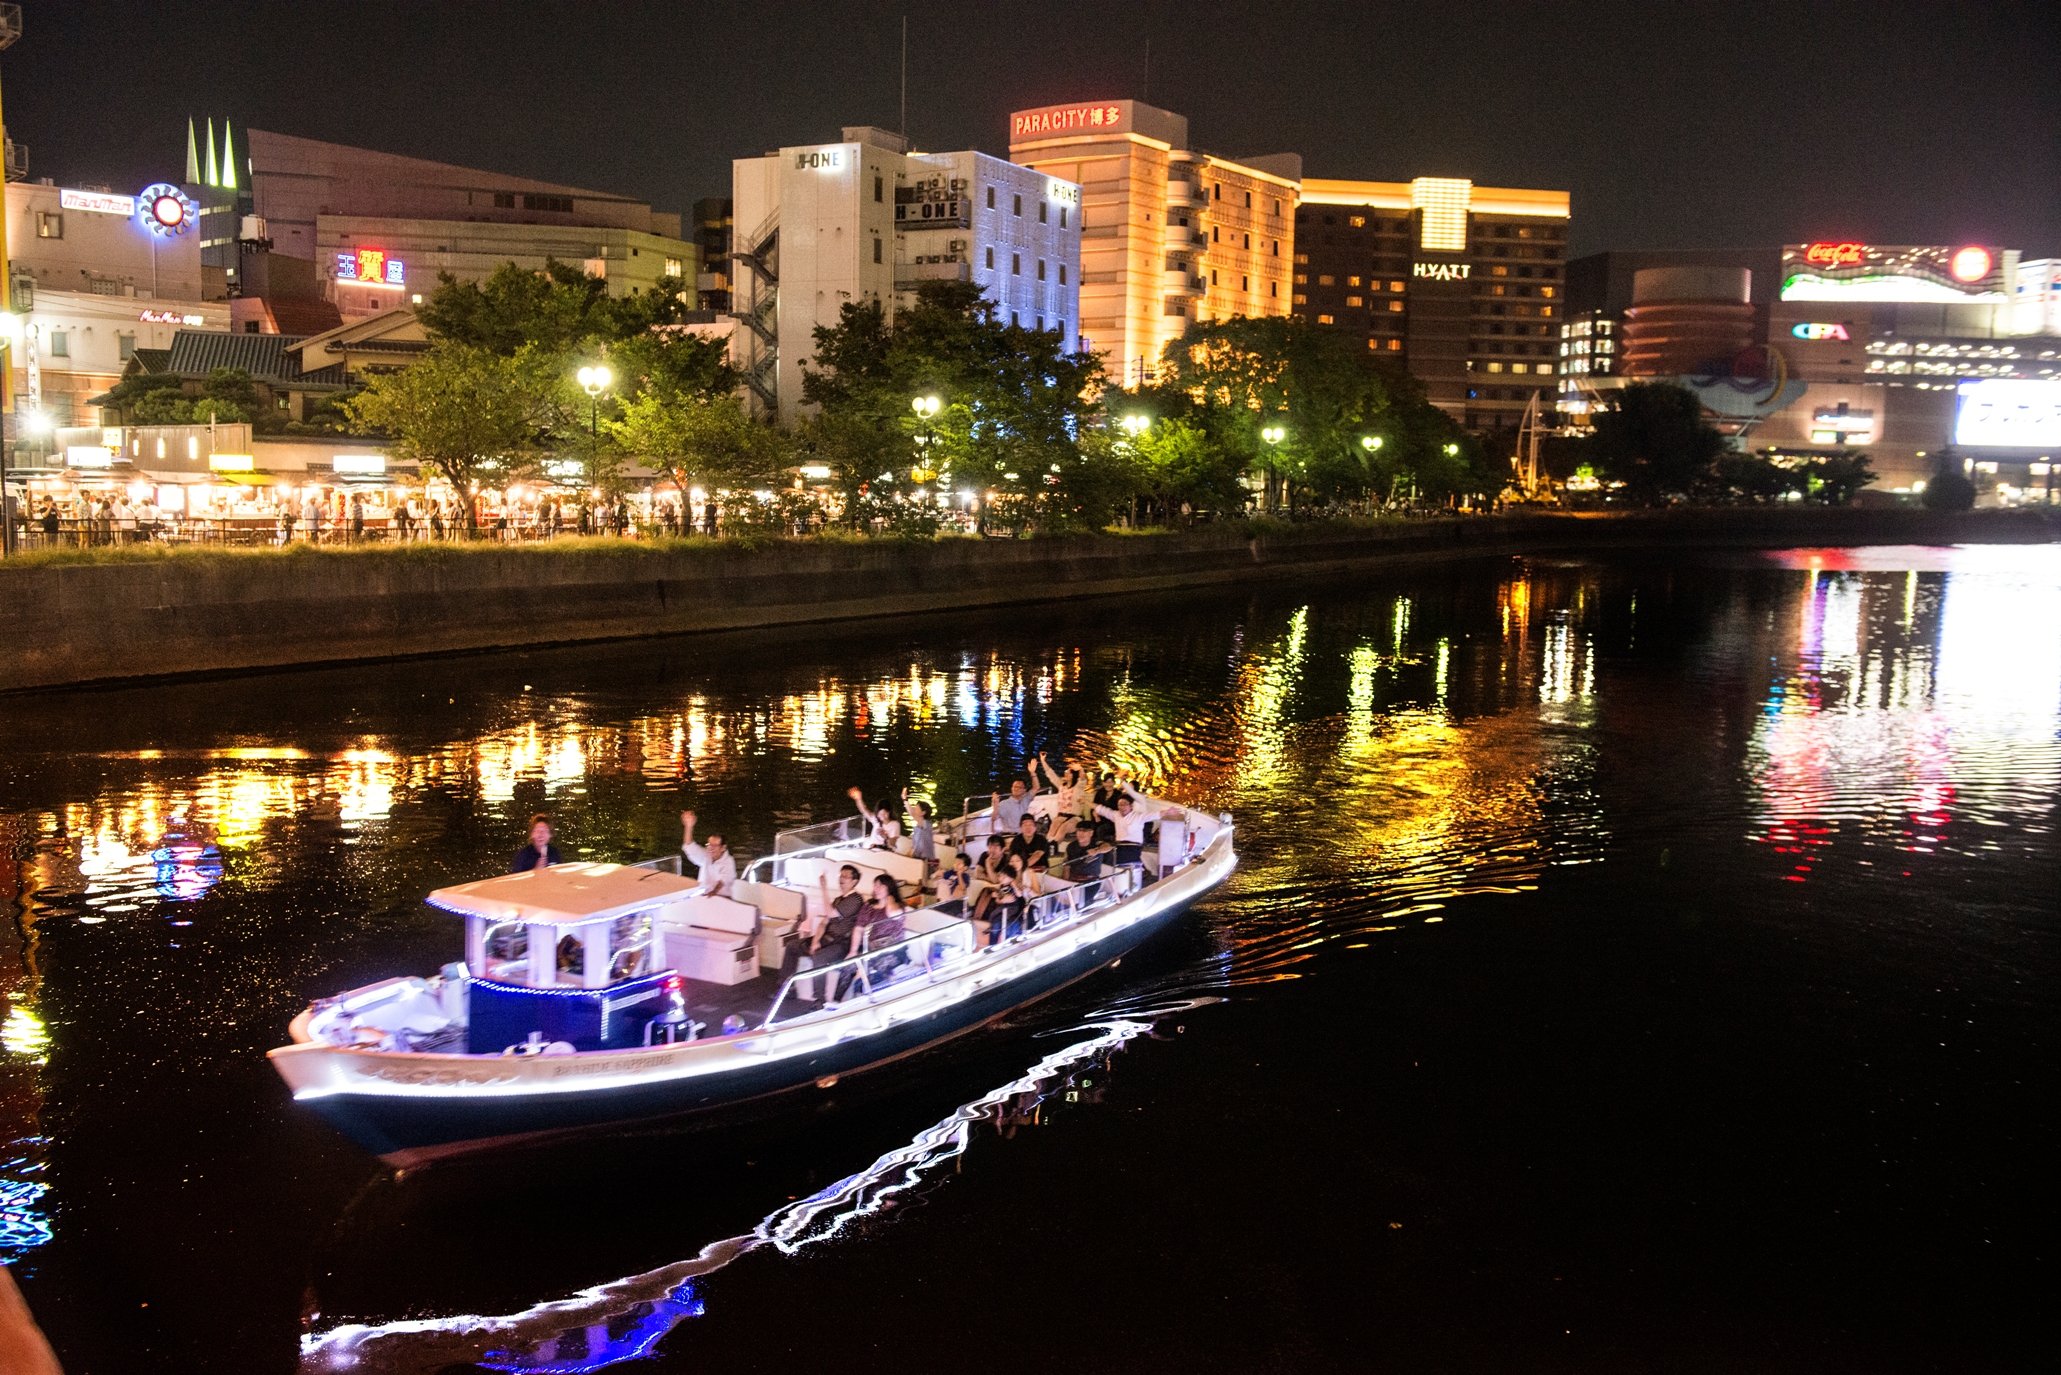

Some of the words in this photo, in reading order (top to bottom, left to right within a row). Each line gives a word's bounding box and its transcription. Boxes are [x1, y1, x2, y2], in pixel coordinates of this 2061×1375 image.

[1090, 107, 1119, 125] 博多
[1806, 243, 1862, 263] Coca-Cola
[1413, 263, 1471, 281] HYATT
[140, 309, 182, 324] ManMan
